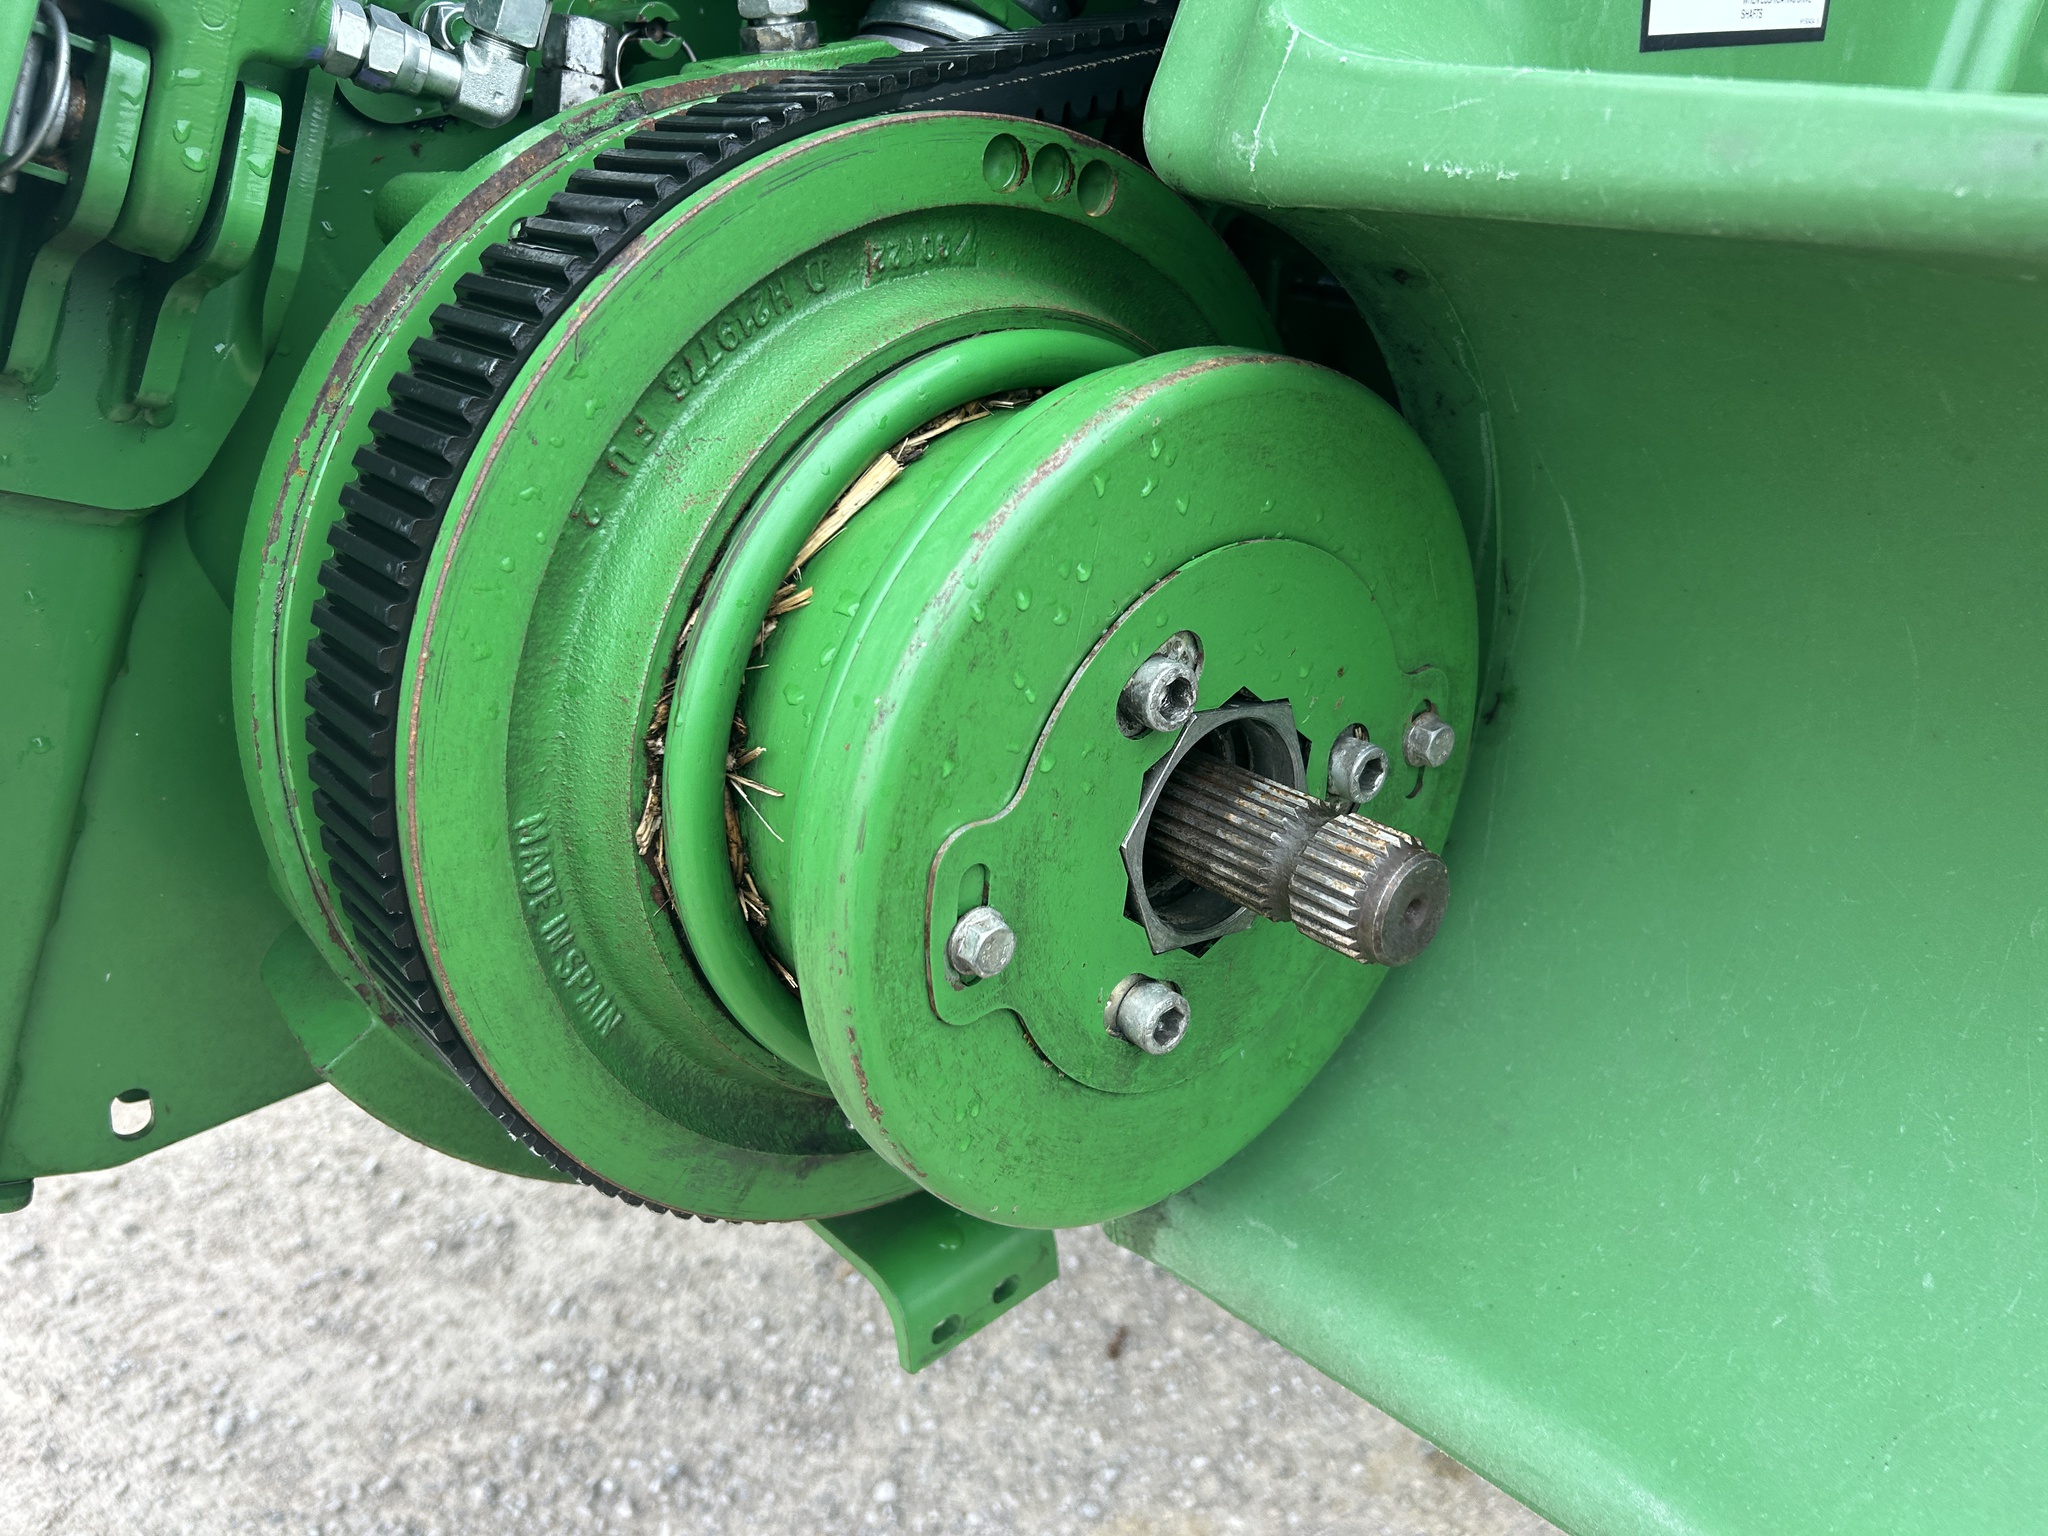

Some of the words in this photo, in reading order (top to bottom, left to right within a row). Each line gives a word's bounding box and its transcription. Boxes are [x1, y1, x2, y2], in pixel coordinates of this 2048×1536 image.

[513, 811, 562, 910] MADE
[540, 913, 576, 954] IN
[553, 948, 626, 1039] SPAIN
